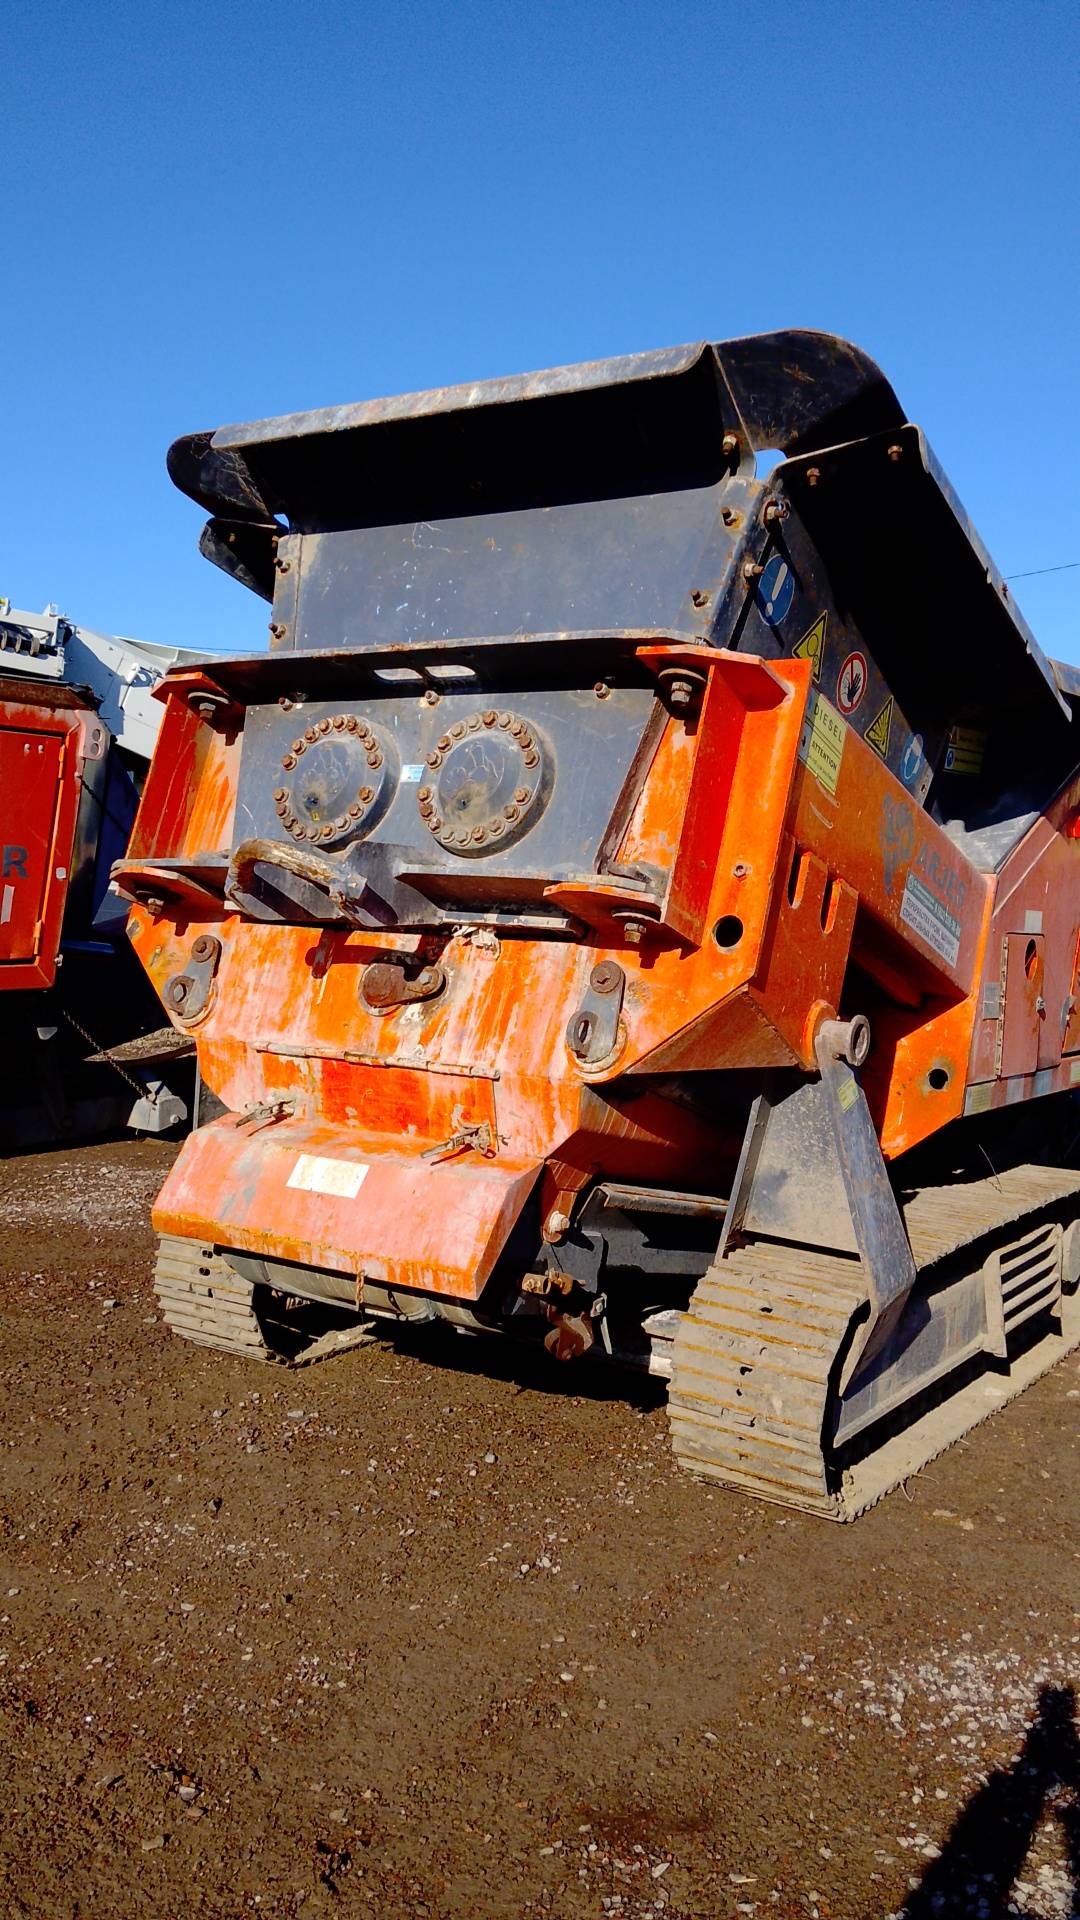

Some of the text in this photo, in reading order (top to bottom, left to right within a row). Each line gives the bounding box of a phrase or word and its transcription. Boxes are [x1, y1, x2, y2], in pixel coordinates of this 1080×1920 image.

[814, 702, 842, 743] DIESEL
[812, 740, 837, 771] ATTENTION
[916, 842, 967, 911] ARJES
